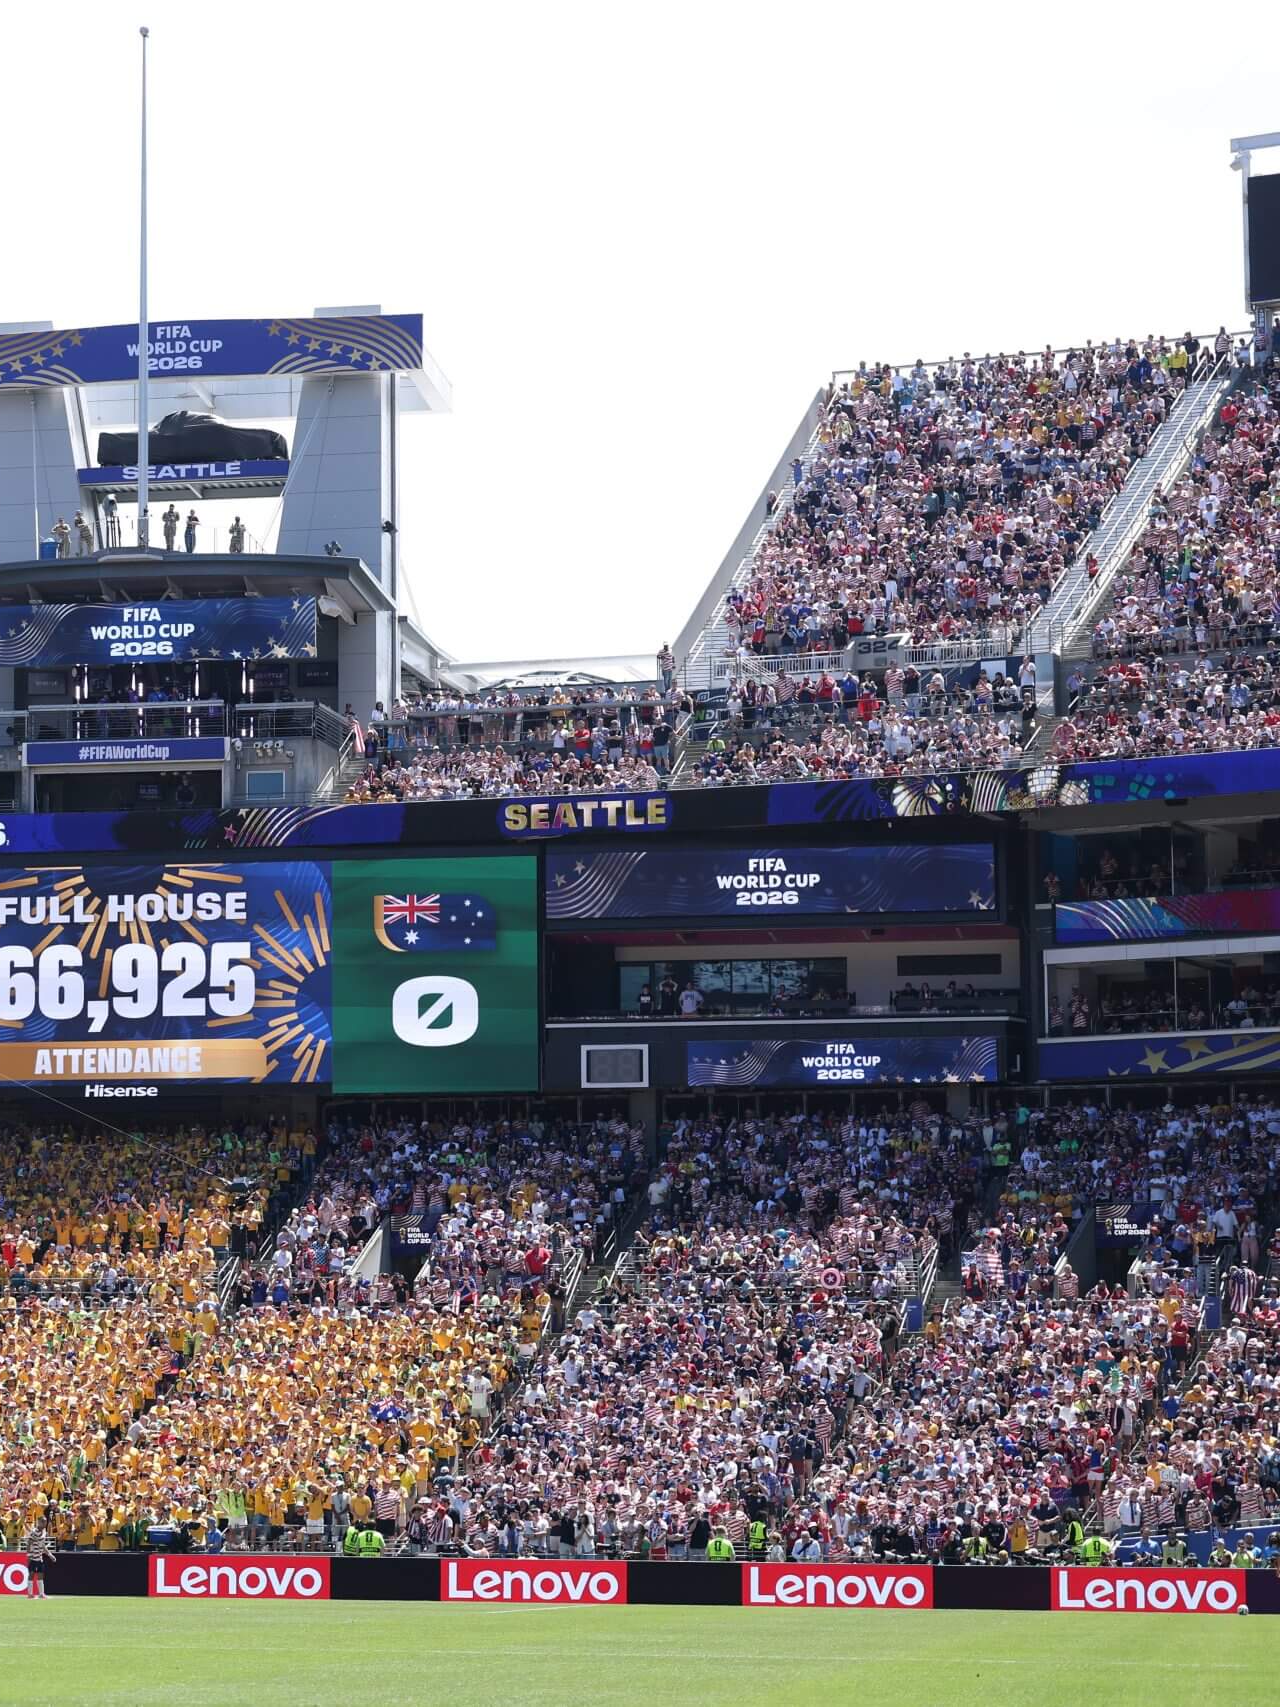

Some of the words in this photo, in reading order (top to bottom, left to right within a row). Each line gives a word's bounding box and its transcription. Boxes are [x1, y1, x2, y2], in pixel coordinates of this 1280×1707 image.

[155, 325, 192, 339] FIFA
[126, 340, 187, 357] WORLD
[189, 339, 223, 353] CUP
[147, 355, 203, 371] 2026
[122, 462, 241, 480] SEATTLE
[122, 607, 162, 623] FIFA
[90, 624, 156, 640] WORLD
[158, 623, 196, 638] CUP
[110, 640, 174, 657] 2026
[858, 640, 898, 654] 324
[78, 744, 170, 761] #FIFAWorldCup
[504, 797, 667, 831] SEATTLE
[748, 857, 787, 873] FIFA
[716, 874, 782, 889] WORLD
[784, 873, 821, 888] CUP
[736, 890, 799, 906] 2026
[107, 891, 247, 923] HOUSE
[392, 975, 479, 1047] 0
[826, 1043, 856, 1055] FIFA
[33, 1046, 202, 1075] ATTENDANCE
[802, 1056, 852, 1068] WORLD
[853, 1055, 881, 1067] CUP
[816, 1068, 865, 1080] 2026
[84, 1084, 158, 1098] Hisense
[156, 1557, 322, 1597] Lenovo
[448, 1561, 619, 1601] Lenovo
[750, 1566, 925, 1606] Lenovo
[1058, 1570, 1238, 1611] Lenovo
